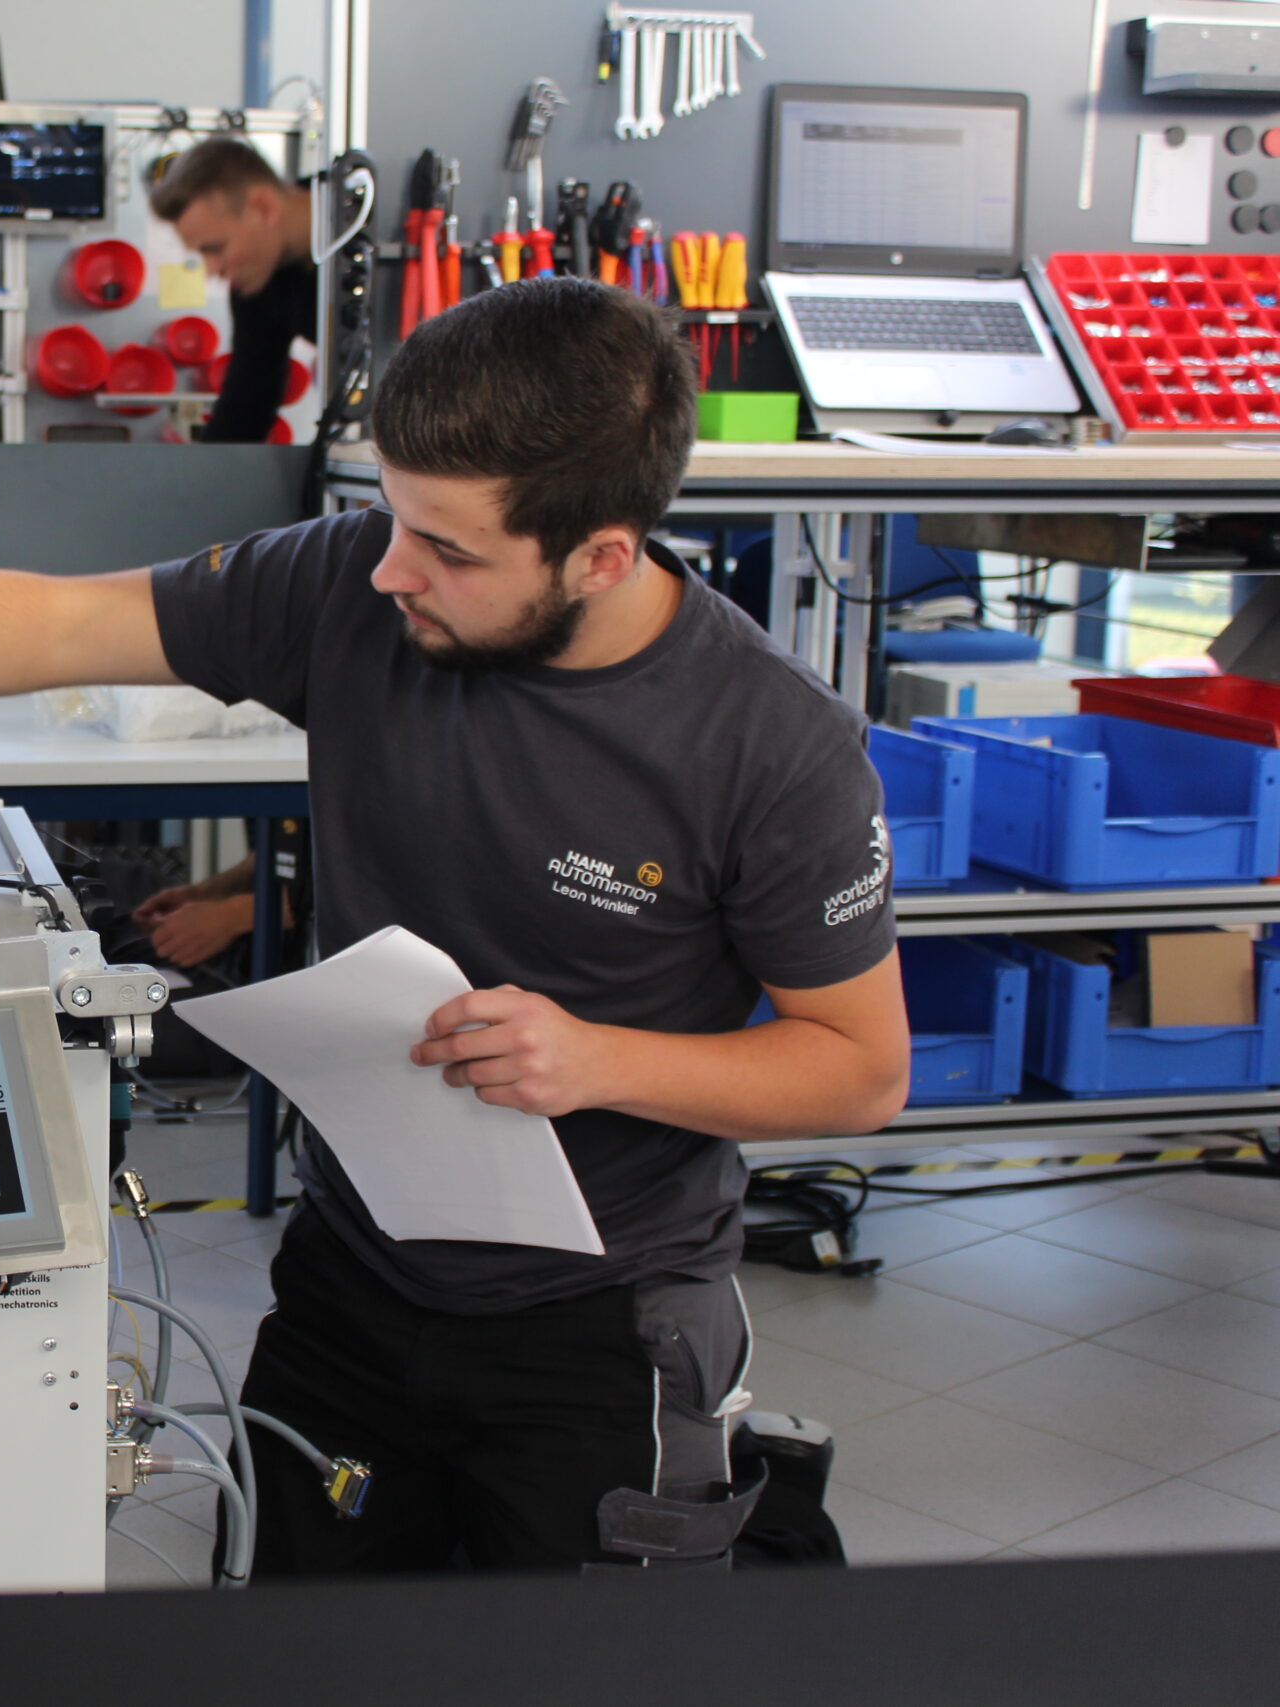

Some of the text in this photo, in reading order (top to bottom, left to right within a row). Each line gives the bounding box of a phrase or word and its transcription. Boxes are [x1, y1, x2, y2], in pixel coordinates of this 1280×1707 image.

[566, 850, 615, 878] HAHN
[548, 858, 657, 904] AUTOMATION
[552, 880, 640, 915] Leon Winkler
[25, 1274, 51, 1282] skills
